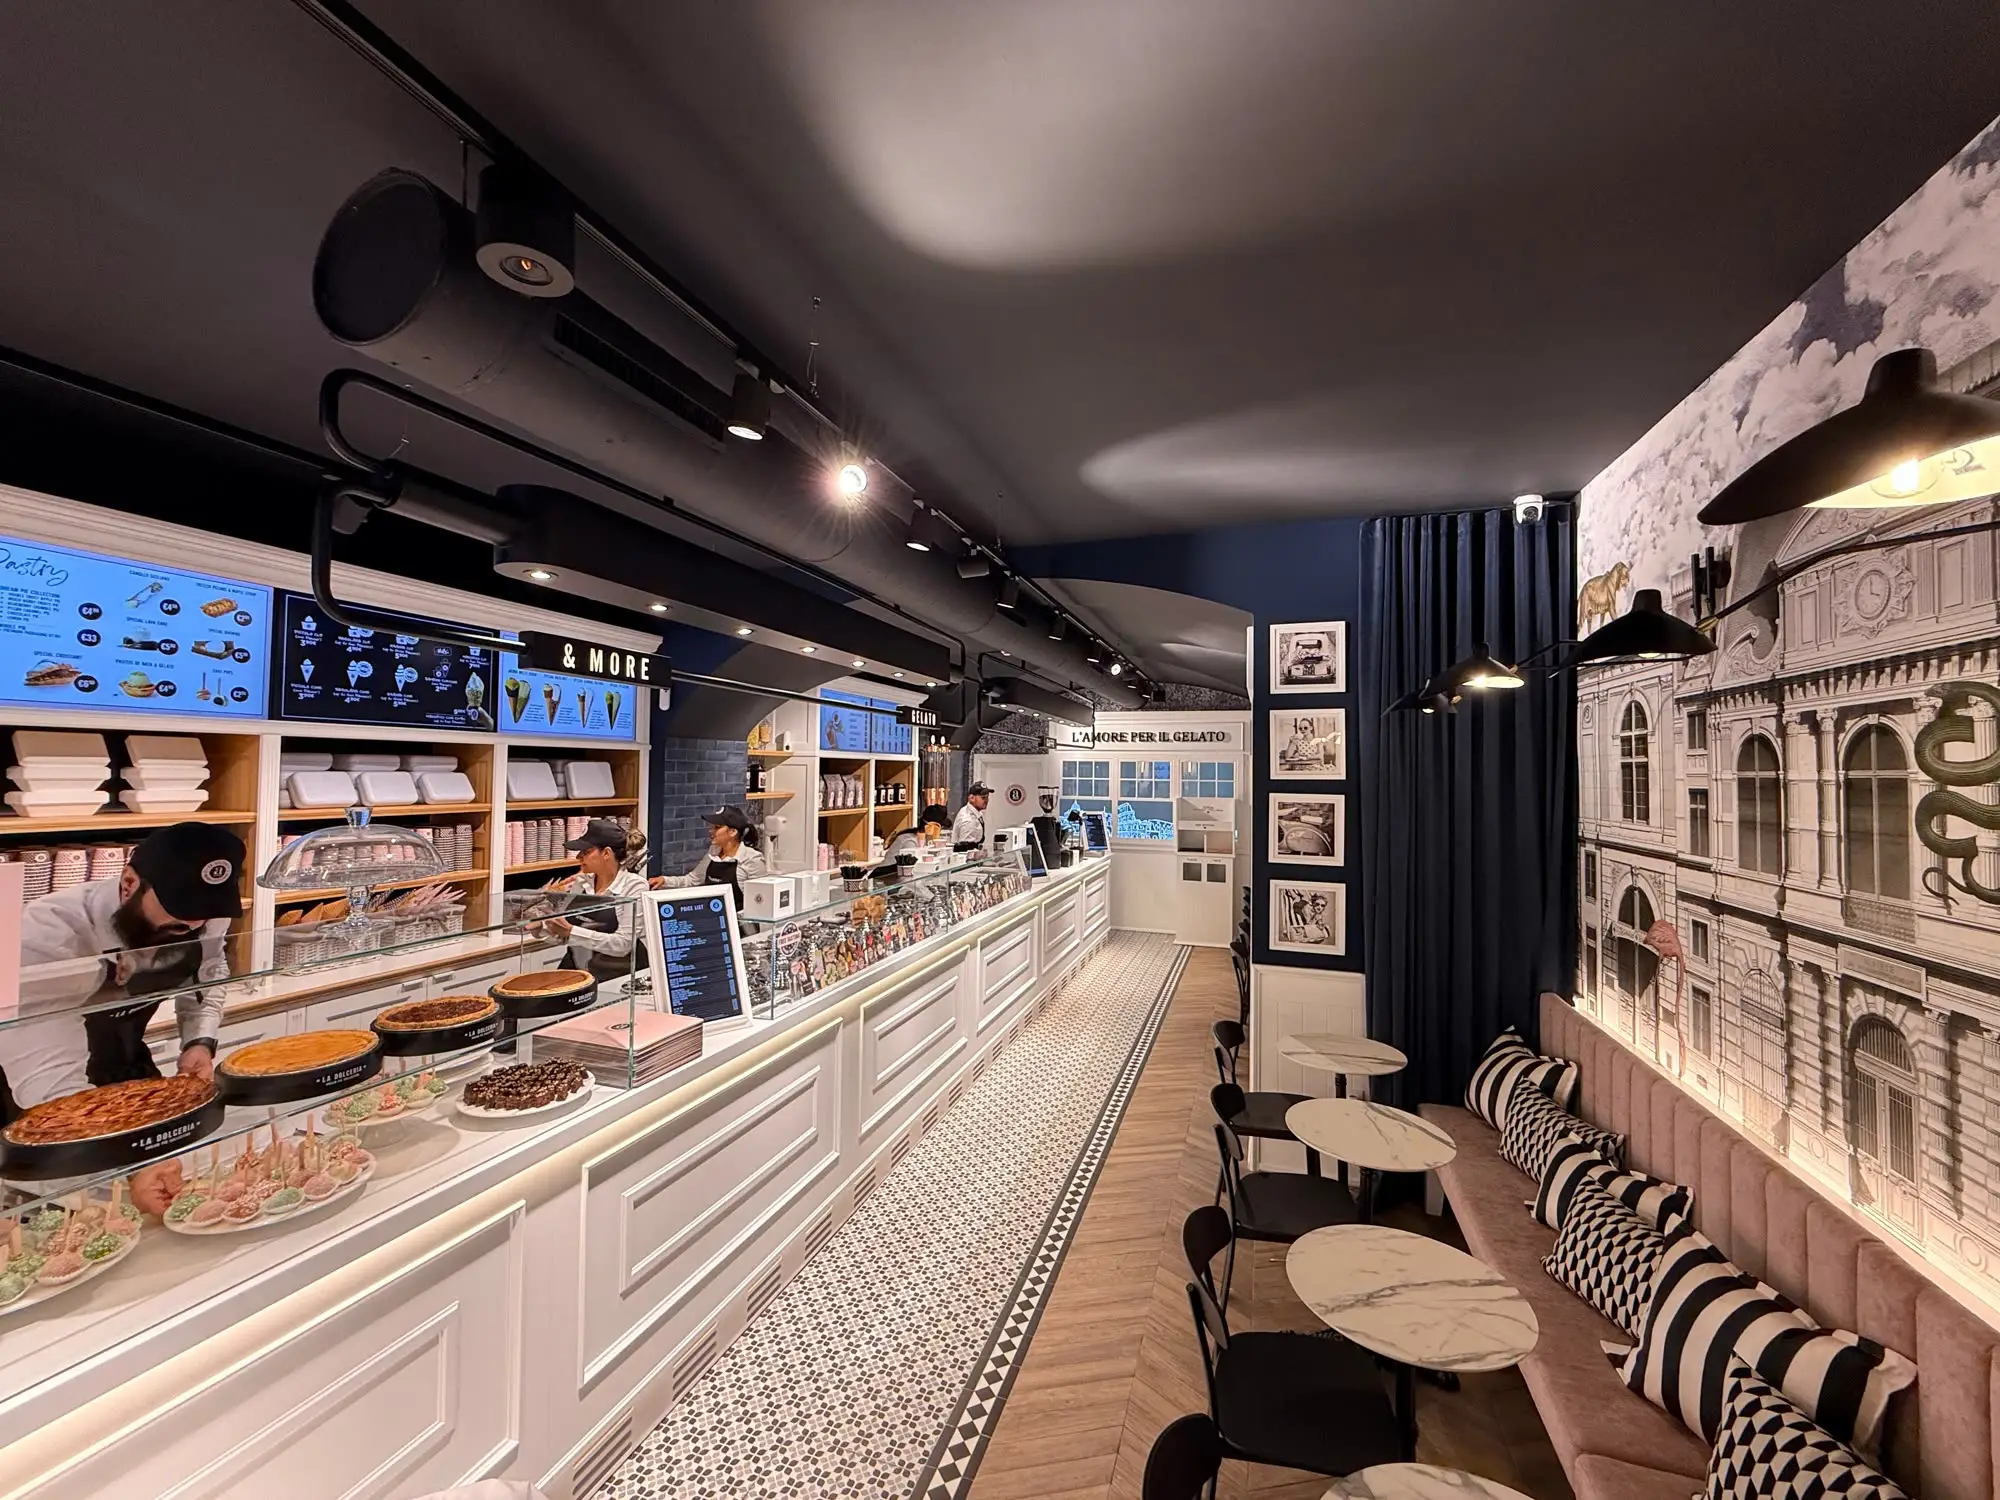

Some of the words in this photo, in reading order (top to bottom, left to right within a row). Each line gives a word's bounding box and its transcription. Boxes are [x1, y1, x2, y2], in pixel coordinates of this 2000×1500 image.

[562, 643, 576, 669] &
[590, 648, 650, 680] MORE
[911, 709, 937, 726] GELATO
[1072, 731, 1128, 743] L'AMORE
[1130, 732, 1154, 743] PER
[1158, 732, 1170, 742] IL
[1172, 731, 1226, 742] GELATO
[334, 1065, 363, 1080] DOLCERIA
[140, 1137, 152, 1147] LA
[156, 1122, 195, 1142] DOLCERIA
